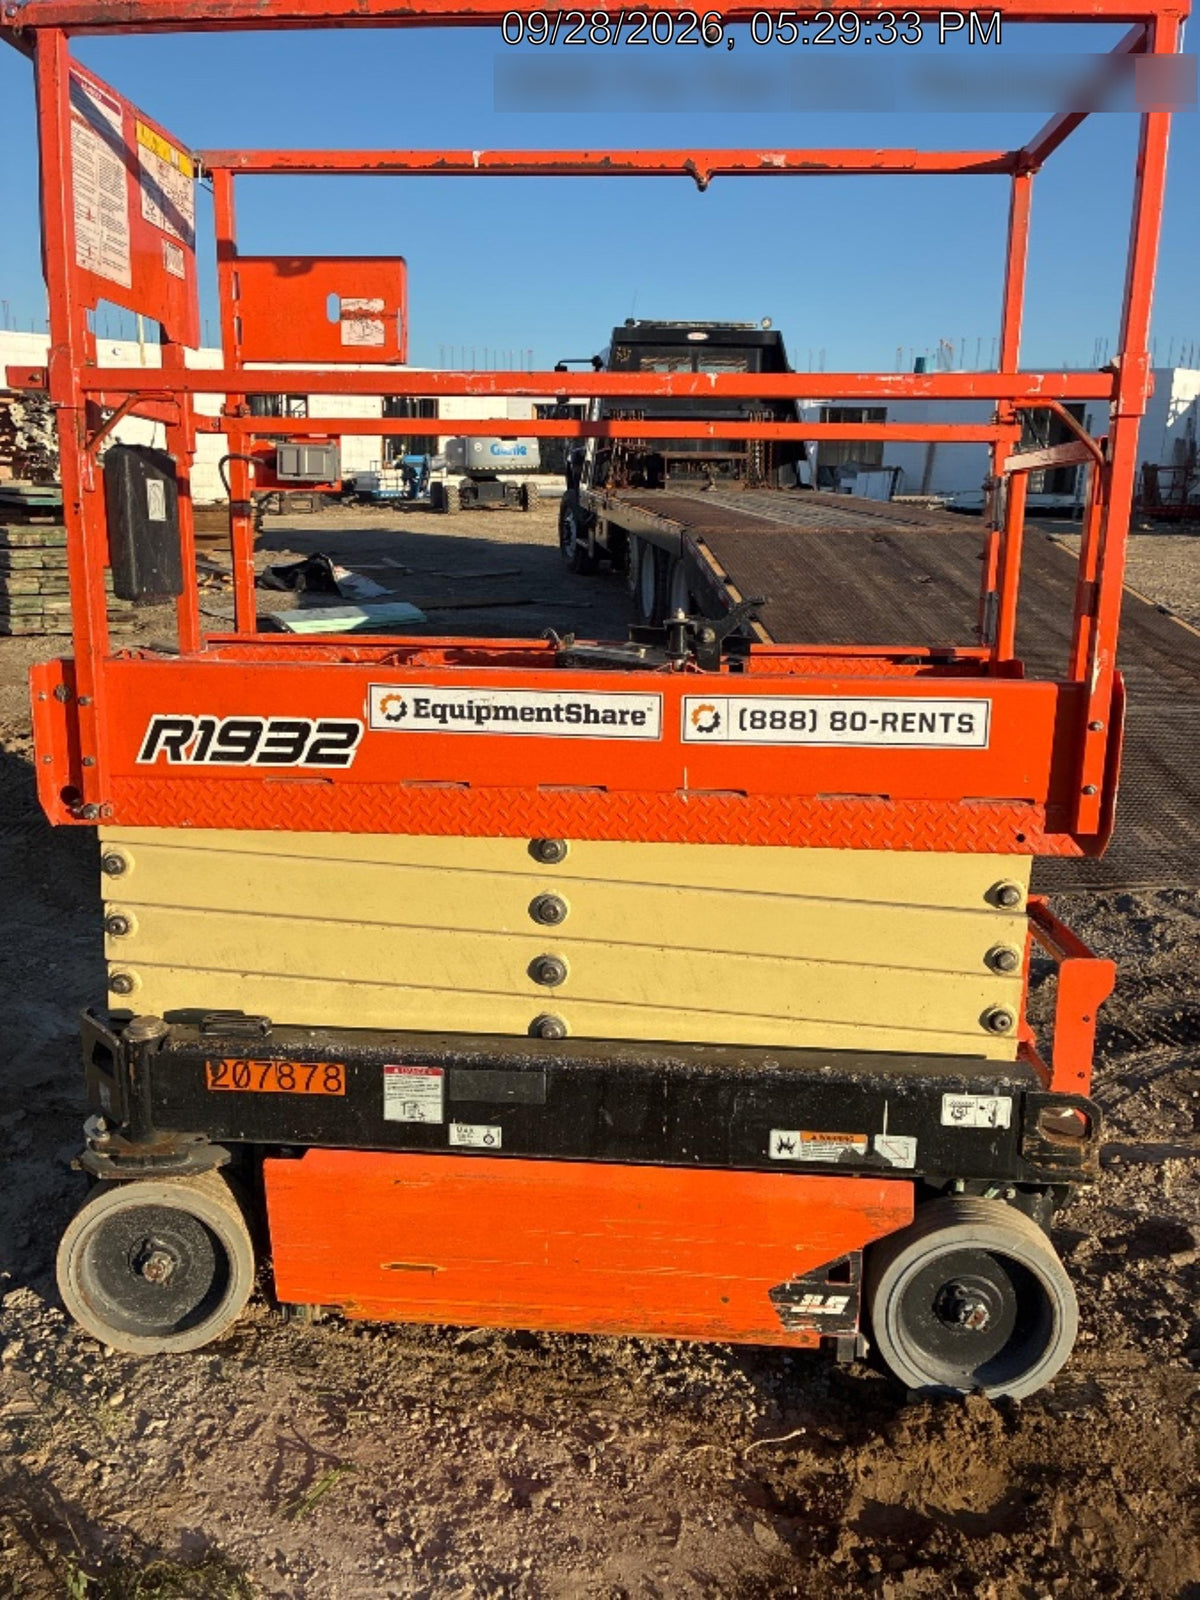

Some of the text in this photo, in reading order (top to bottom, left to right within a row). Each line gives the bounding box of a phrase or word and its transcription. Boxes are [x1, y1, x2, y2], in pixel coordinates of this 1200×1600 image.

[412, 697, 648, 727] EquipmentShare
[738, 708, 975, 734] (888) 80-RENTS
[138, 717, 362, 767] R1932
[210, 1061, 342, 1093] 207878
